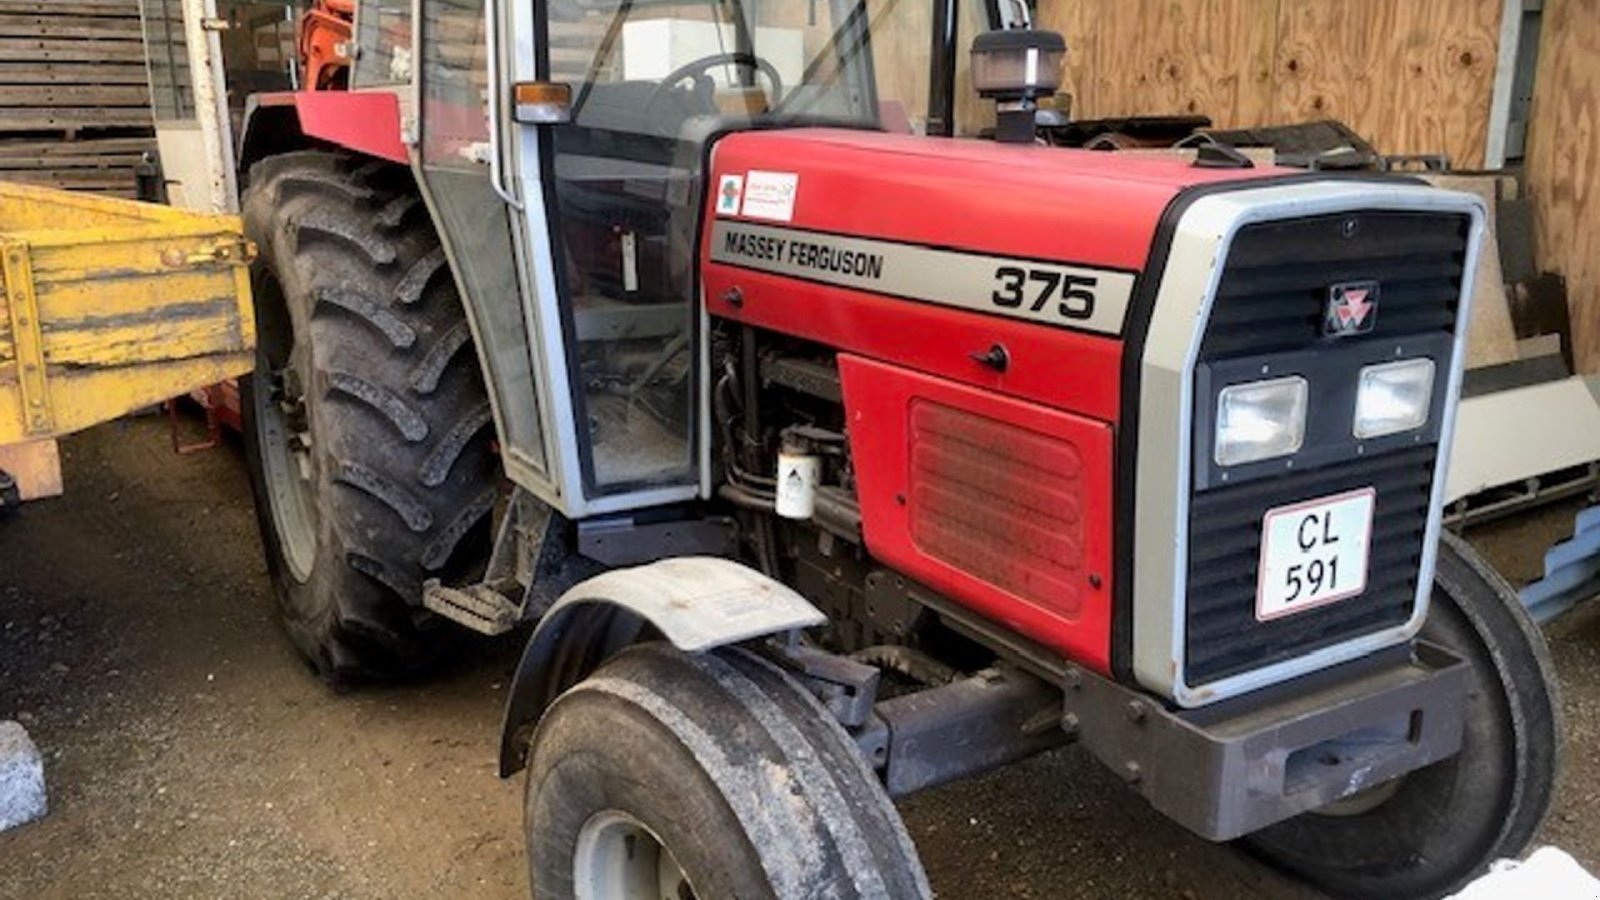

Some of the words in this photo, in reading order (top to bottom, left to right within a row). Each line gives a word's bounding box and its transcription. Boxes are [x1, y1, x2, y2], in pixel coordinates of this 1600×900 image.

[726, 232, 785, 262] MASSEY
[788, 242, 884, 279] FERGUSON
[992, 267, 1097, 319] 375
[1298, 511, 1339, 551] CL
[1285, 555, 1338, 602] 591
